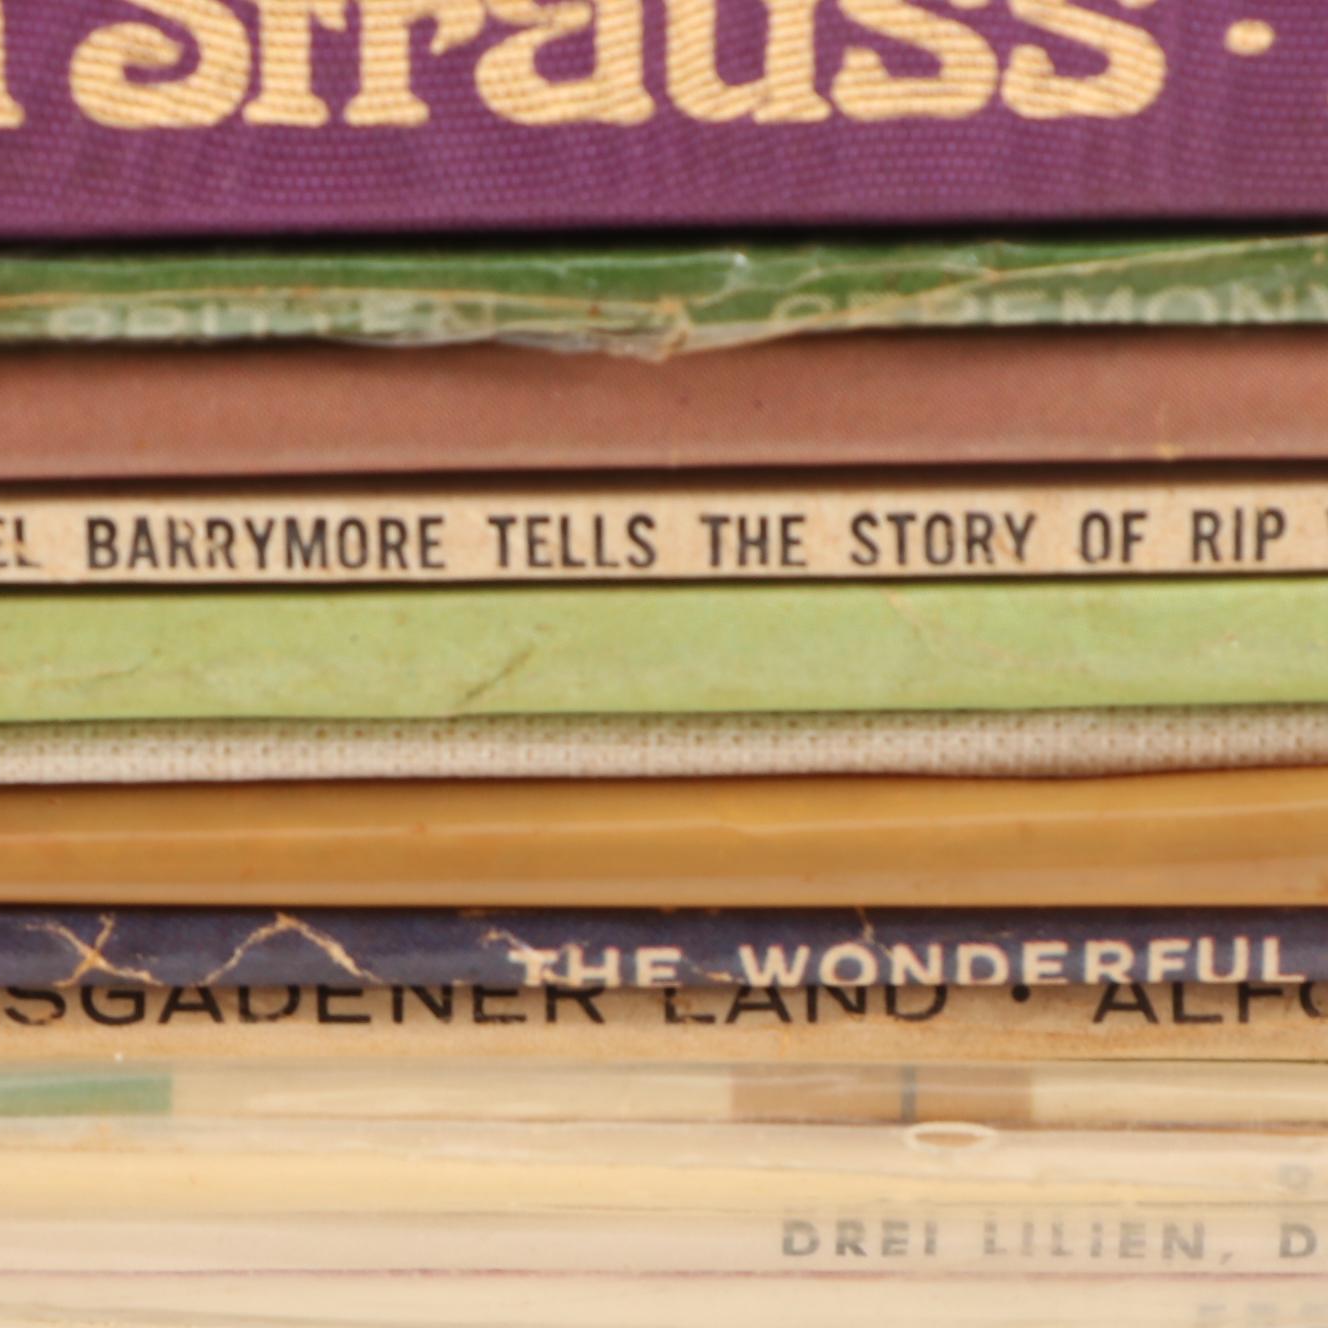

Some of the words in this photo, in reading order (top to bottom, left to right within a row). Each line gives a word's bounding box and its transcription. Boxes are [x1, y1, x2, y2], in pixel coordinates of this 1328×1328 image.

[85, 513, 446, 571] BARRYMORE
[488, 513, 659, 569] TELLS
[699, 513, 807, 568] THE
[849, 510, 1037, 567] STORY
[1078, 510, 1149, 564] OF
[1190, 507, 1289, 563] RIP
[506, 944, 684, 988] THE
[738, 935, 1307, 986] WONDERFUL
[780, 1217, 940, 1259] DREI
